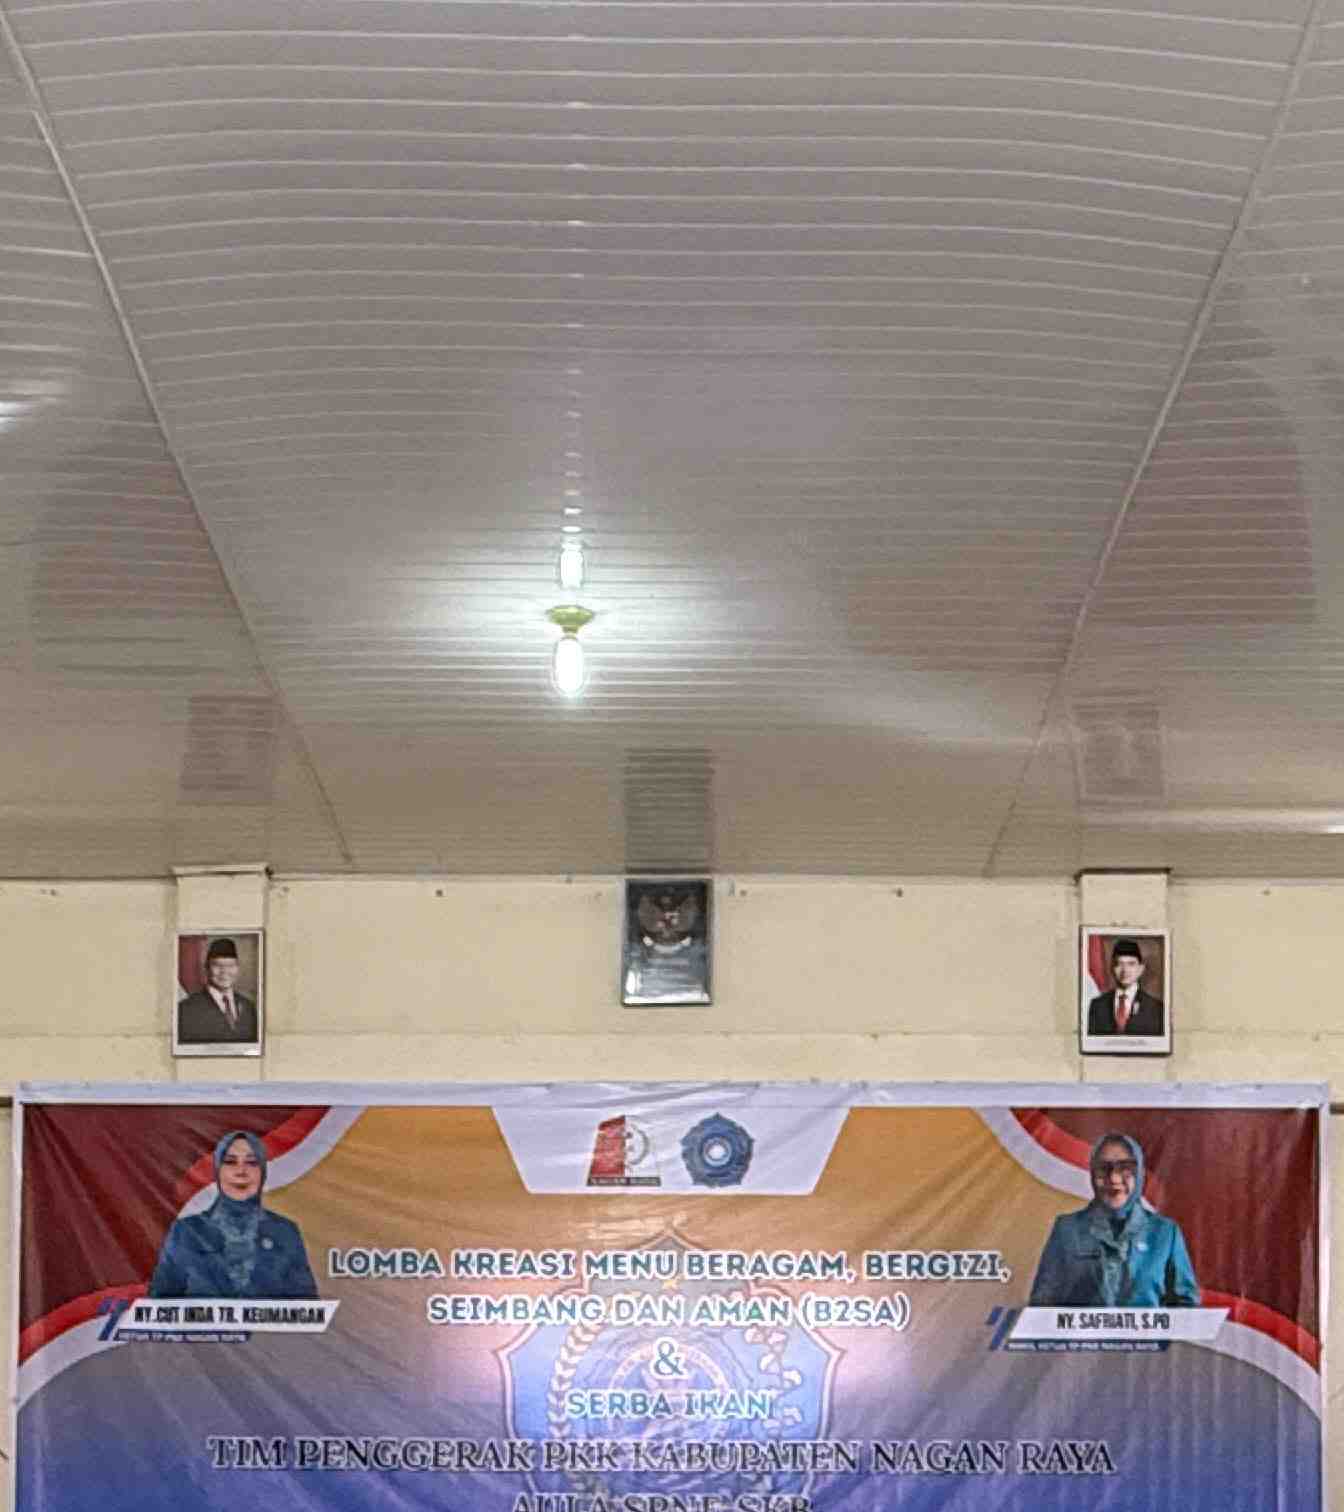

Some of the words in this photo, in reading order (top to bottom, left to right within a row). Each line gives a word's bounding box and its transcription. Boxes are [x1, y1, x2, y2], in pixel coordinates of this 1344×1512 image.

[329, 1250, 443, 1277] LOMBA
[452, 1251, 575, 1277] KREASI
[584, 1252, 676, 1277] MENU
[685, 1252, 855, 1281] BERAGAM,
[864, 1252, 1010, 1281] BERGIZI,
[428, 1297, 603, 1322] SEIMBANG
[613, 1298, 682, 1322] DAN
[692, 1299, 790, 1323] AMAN
[802, 1295, 909, 1327] (B2SA)
[653, 1340, 685, 1376] &
[567, 1391, 674, 1417] SERBA
[684, 1391, 770, 1418] IKAN
[208, 1438, 287, 1468] TIM
[296, 1439, 532, 1469] PENGGERAK
[543, 1441, 619, 1471] PKK
[632, 1441, 859, 1471] KABUPATEN
[872, 1441, 1007, 1472] NAGAN
[1019, 1441, 1116, 1473] RAYA
